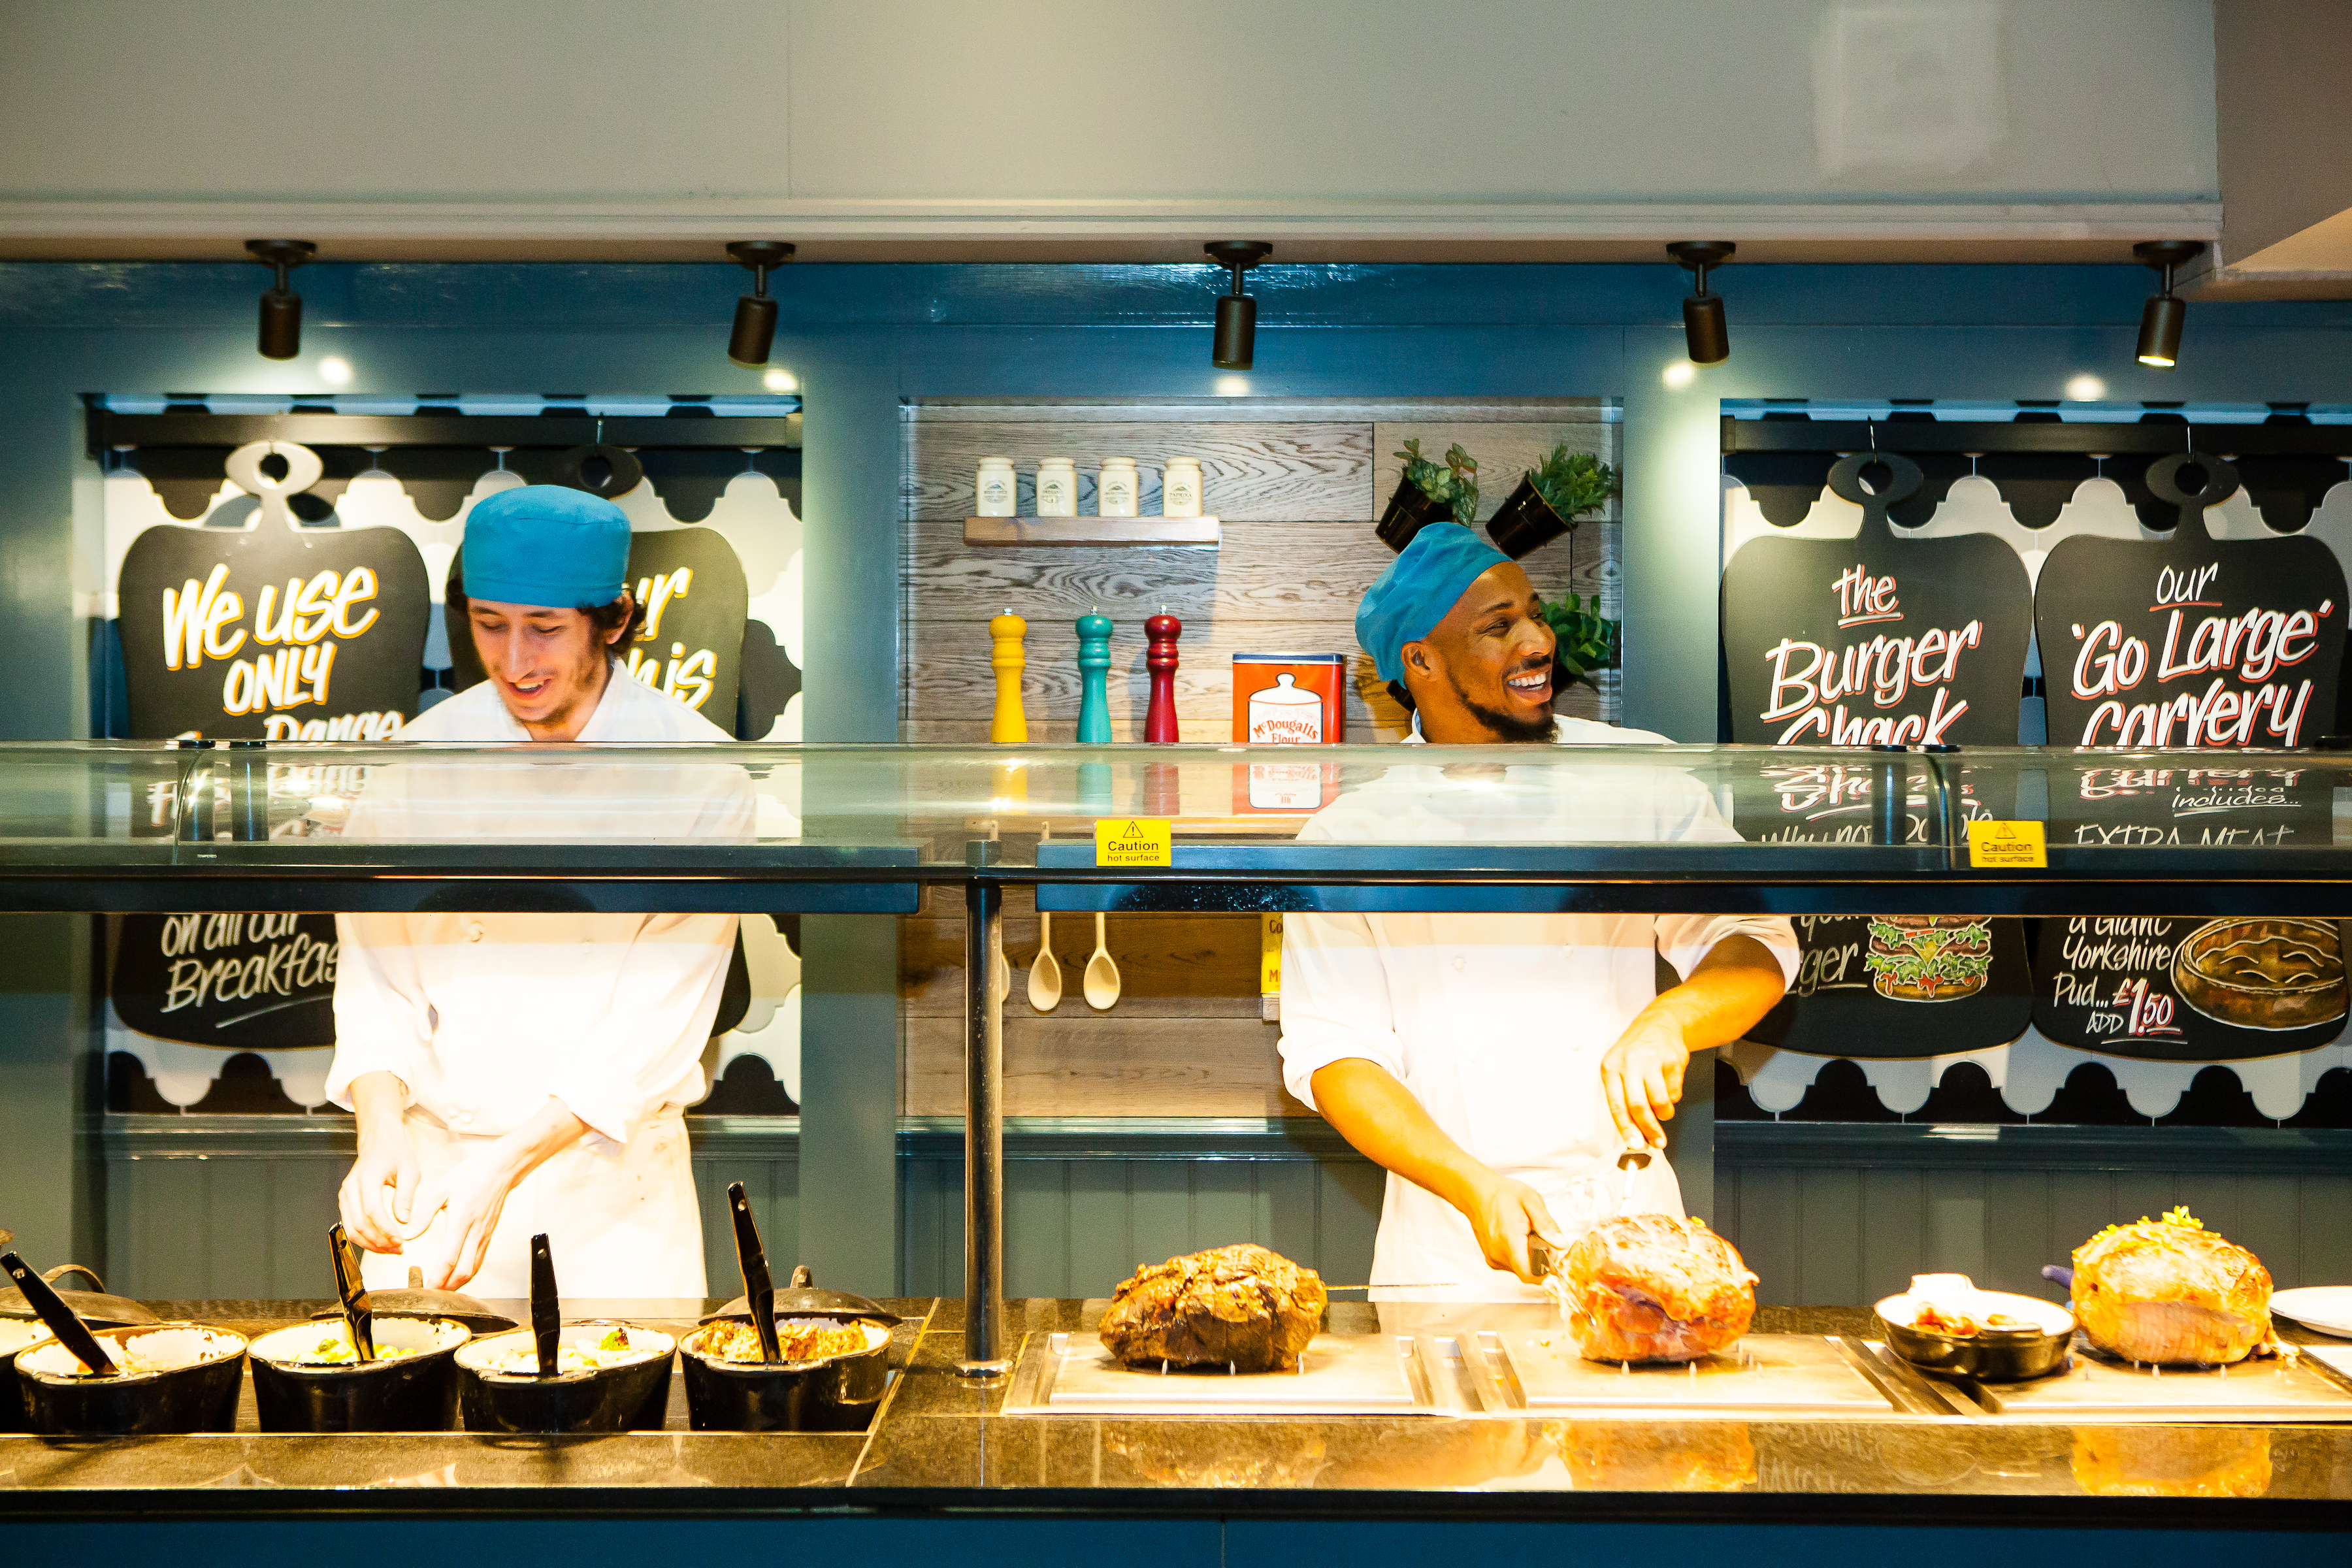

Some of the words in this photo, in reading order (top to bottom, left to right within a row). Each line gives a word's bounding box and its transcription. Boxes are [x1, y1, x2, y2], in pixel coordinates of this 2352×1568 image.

[1831, 564, 1899, 617] the
[2156, 561, 2219, 604] our
[163, 563, 248, 670] We
[1759, 620, 1984, 709] Burger
[1108, 841, 1158, 851] Caution
[1981, 841, 2033, 852] Caution
[159, 932, 339, 1013] Breakfas
[2063, 935, 2172, 971] Yorkshire
[2085, 1011, 2125, 1034] ADD
